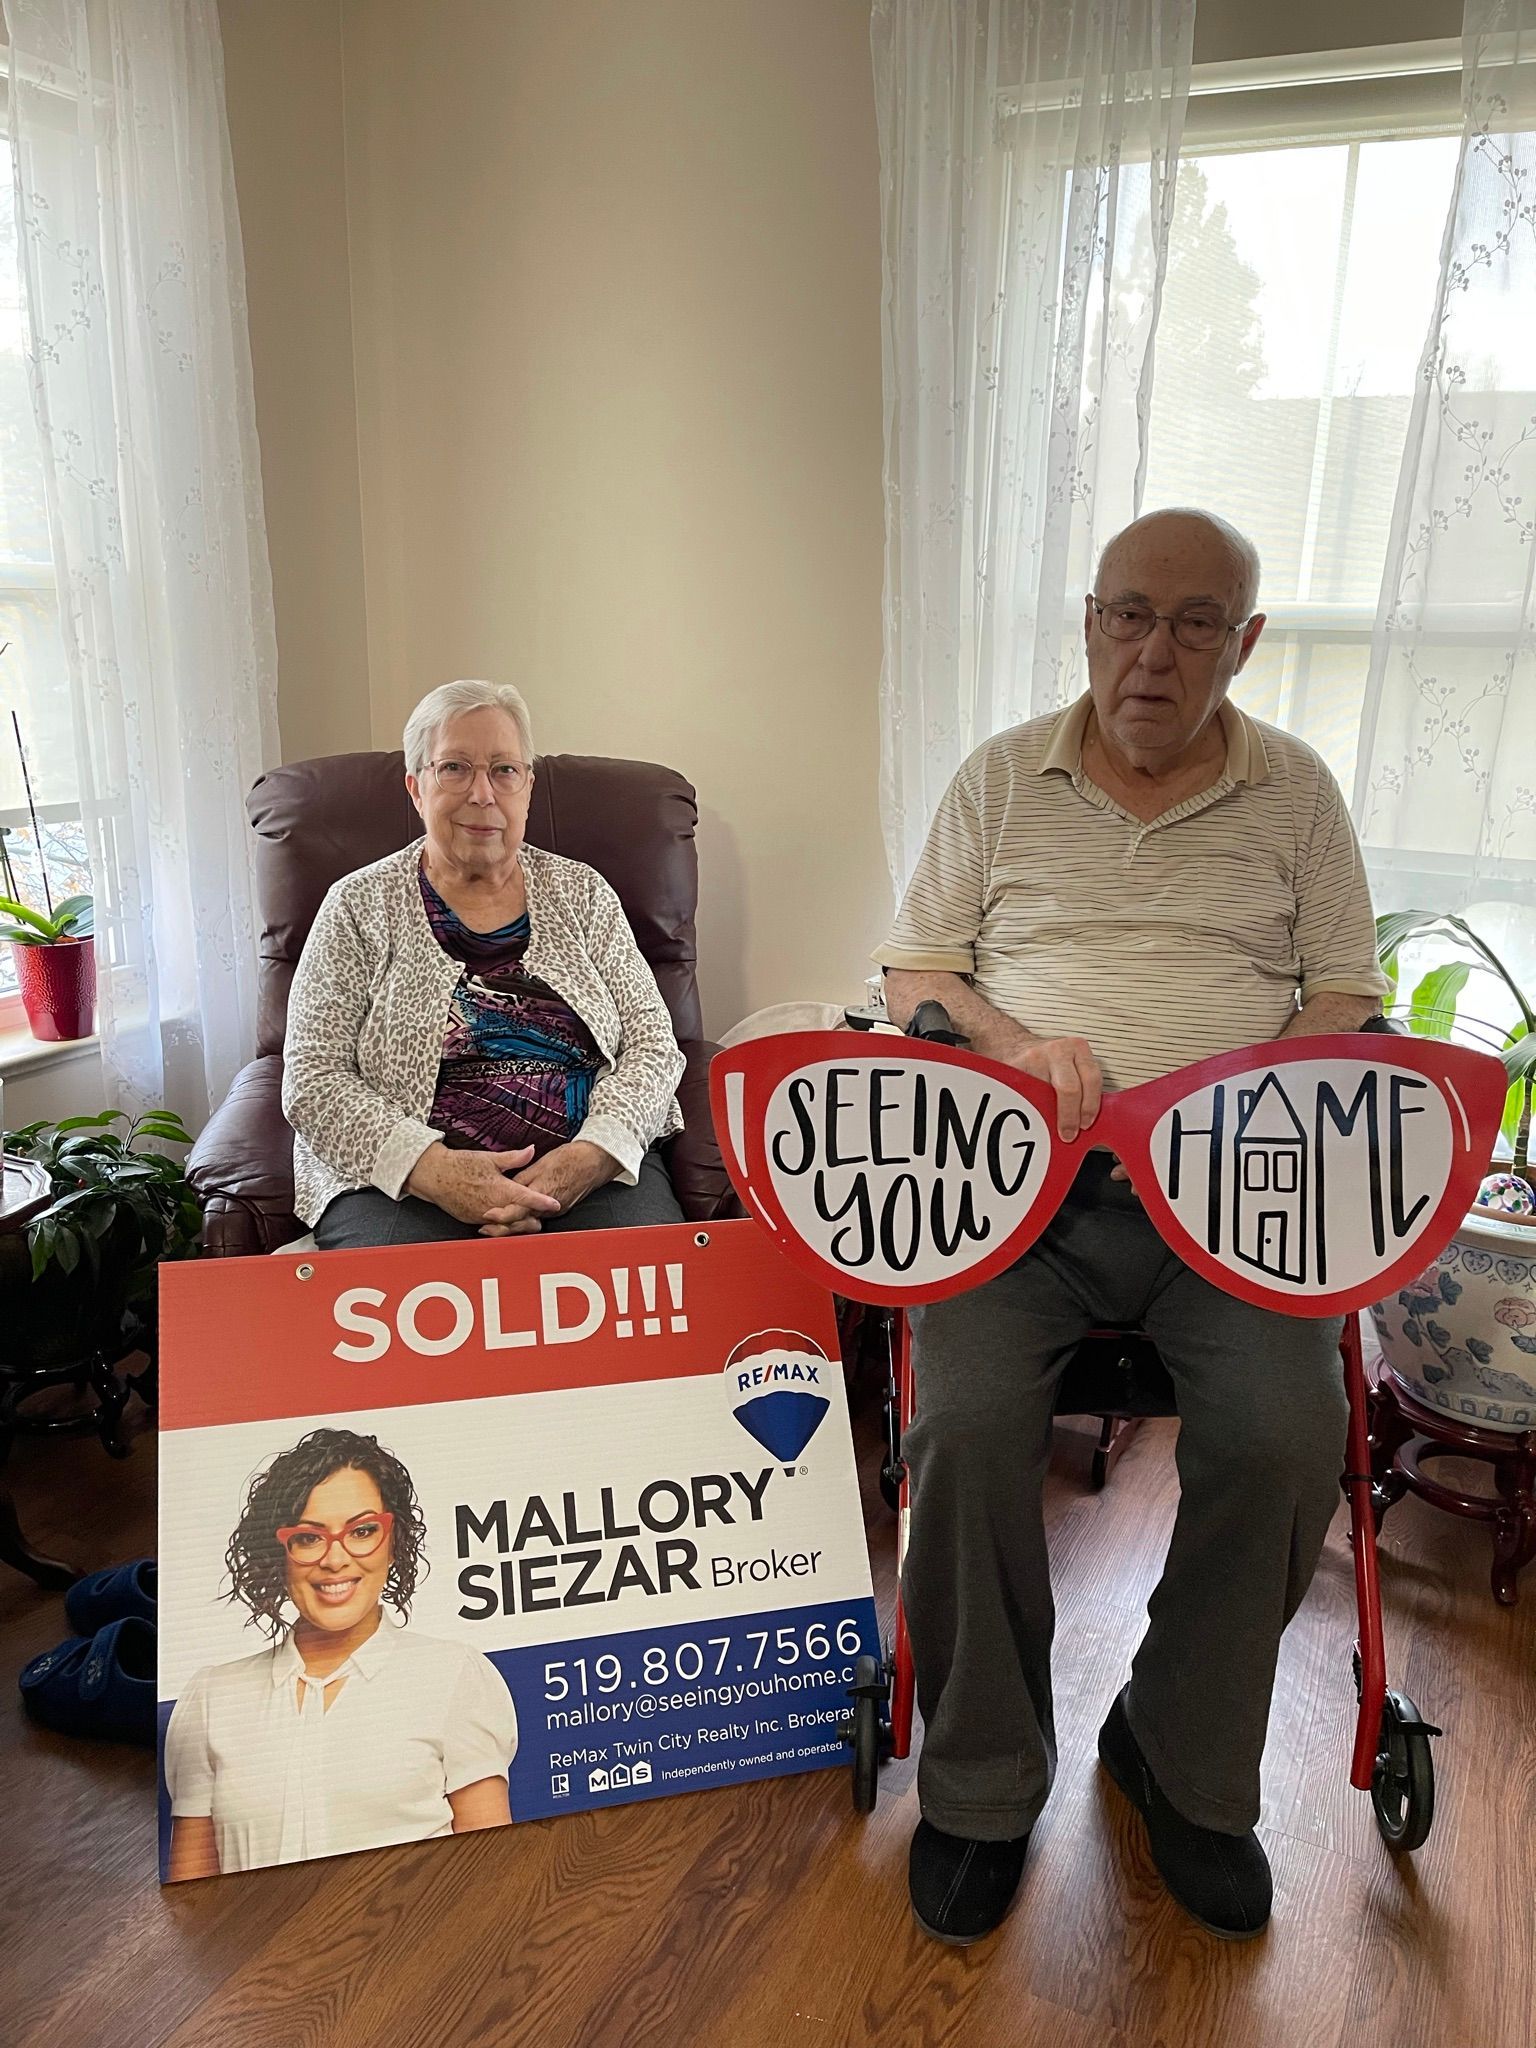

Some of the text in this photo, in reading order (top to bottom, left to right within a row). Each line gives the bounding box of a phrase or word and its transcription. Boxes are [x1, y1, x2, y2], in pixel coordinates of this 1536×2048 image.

[771, 1067, 1037, 1198] SEEING
[1169, 1069, 1431, 1286] HME
[332, 1262, 689, 1363] SOLD!!!
[737, 1363, 820, 1393] RE/MAX
[455, 1467, 774, 1559] MALLORY
[457, 1538, 822, 1621] SIEZAR Broker
[544, 1618, 861, 1701] 519.807.7566
[546, 1666, 854, 1730] mallory@seeingyouhome.c
[550, 1706, 855, 1769] ReMax Twin City Realty Inc. Brokera
[590, 1763, 651, 1790] MLS
[661, 1740, 843, 1780] Independently owned and operated
